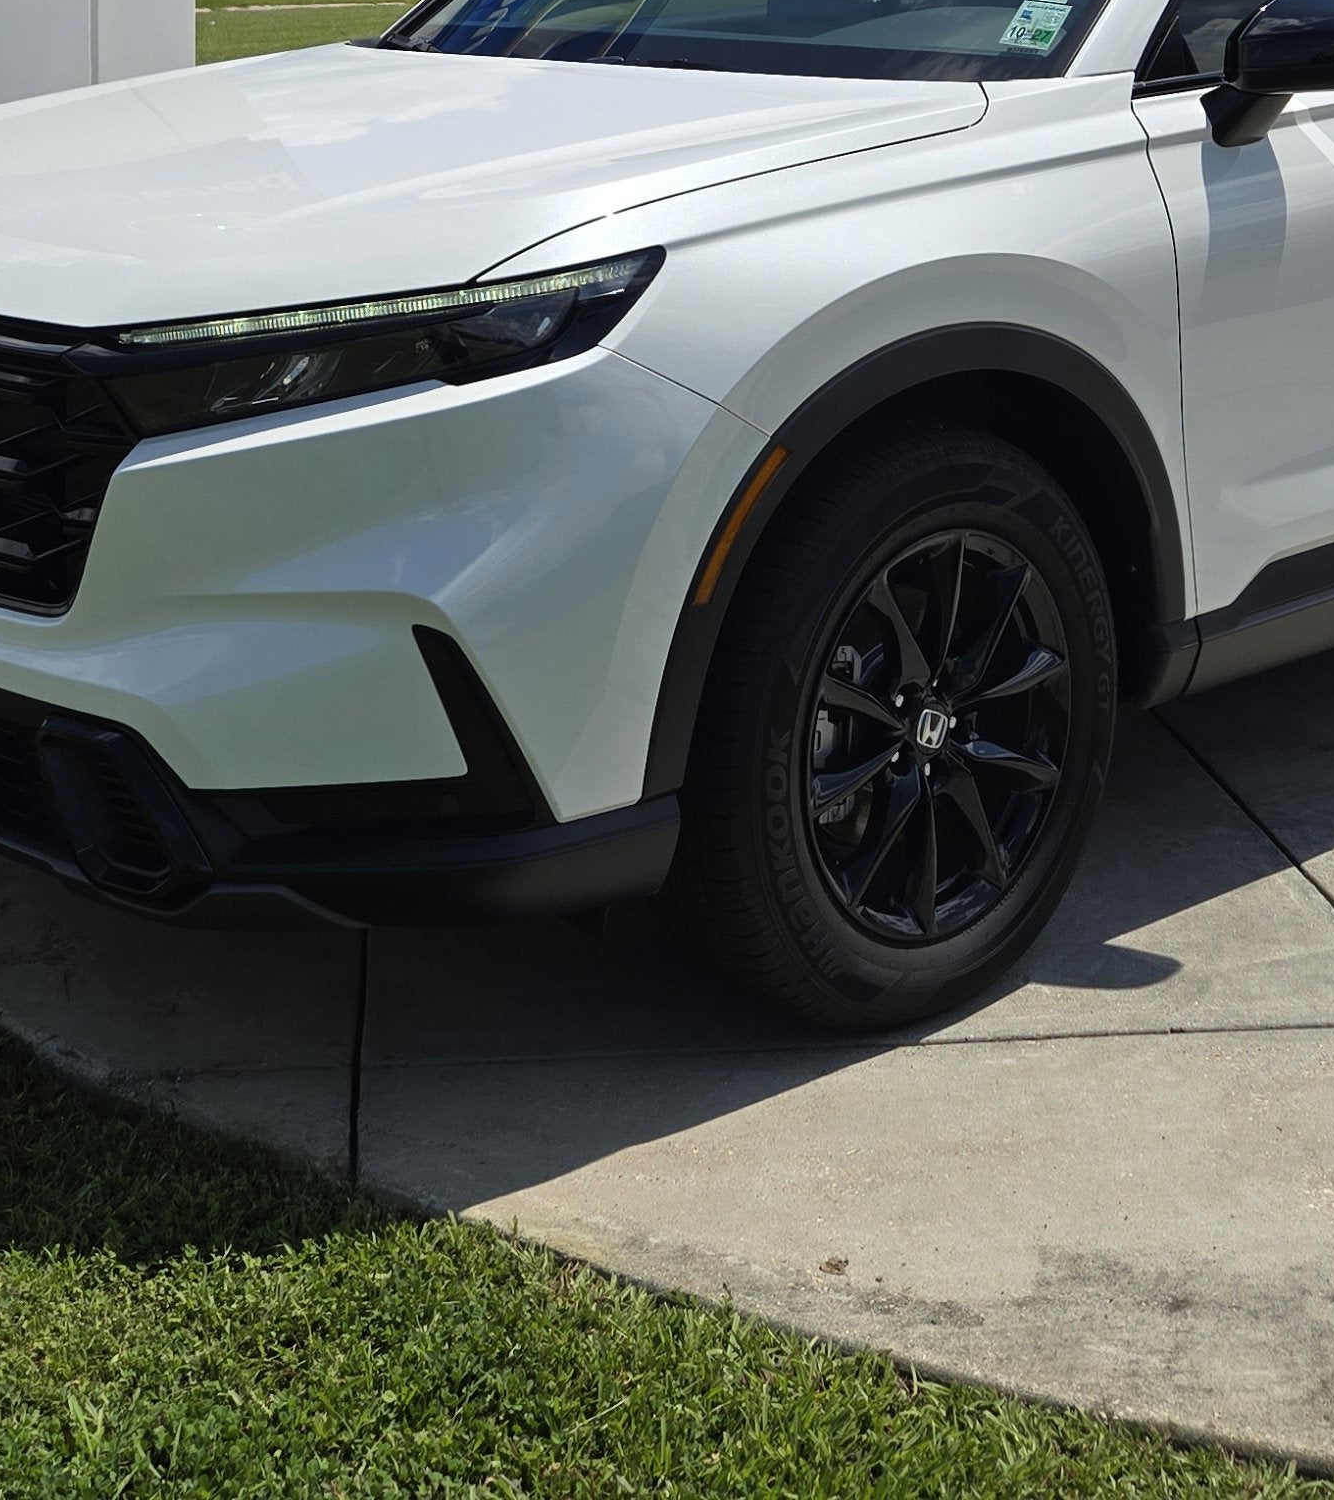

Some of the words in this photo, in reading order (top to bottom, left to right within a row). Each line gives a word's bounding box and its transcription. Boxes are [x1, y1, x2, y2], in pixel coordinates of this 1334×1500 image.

[1033, 27, 1052, 43] 27
[1050, 515, 1112, 664] KINERGY
[1098, 672, 1111, 716] GT
[765, 725, 835, 960] HANKOOK
